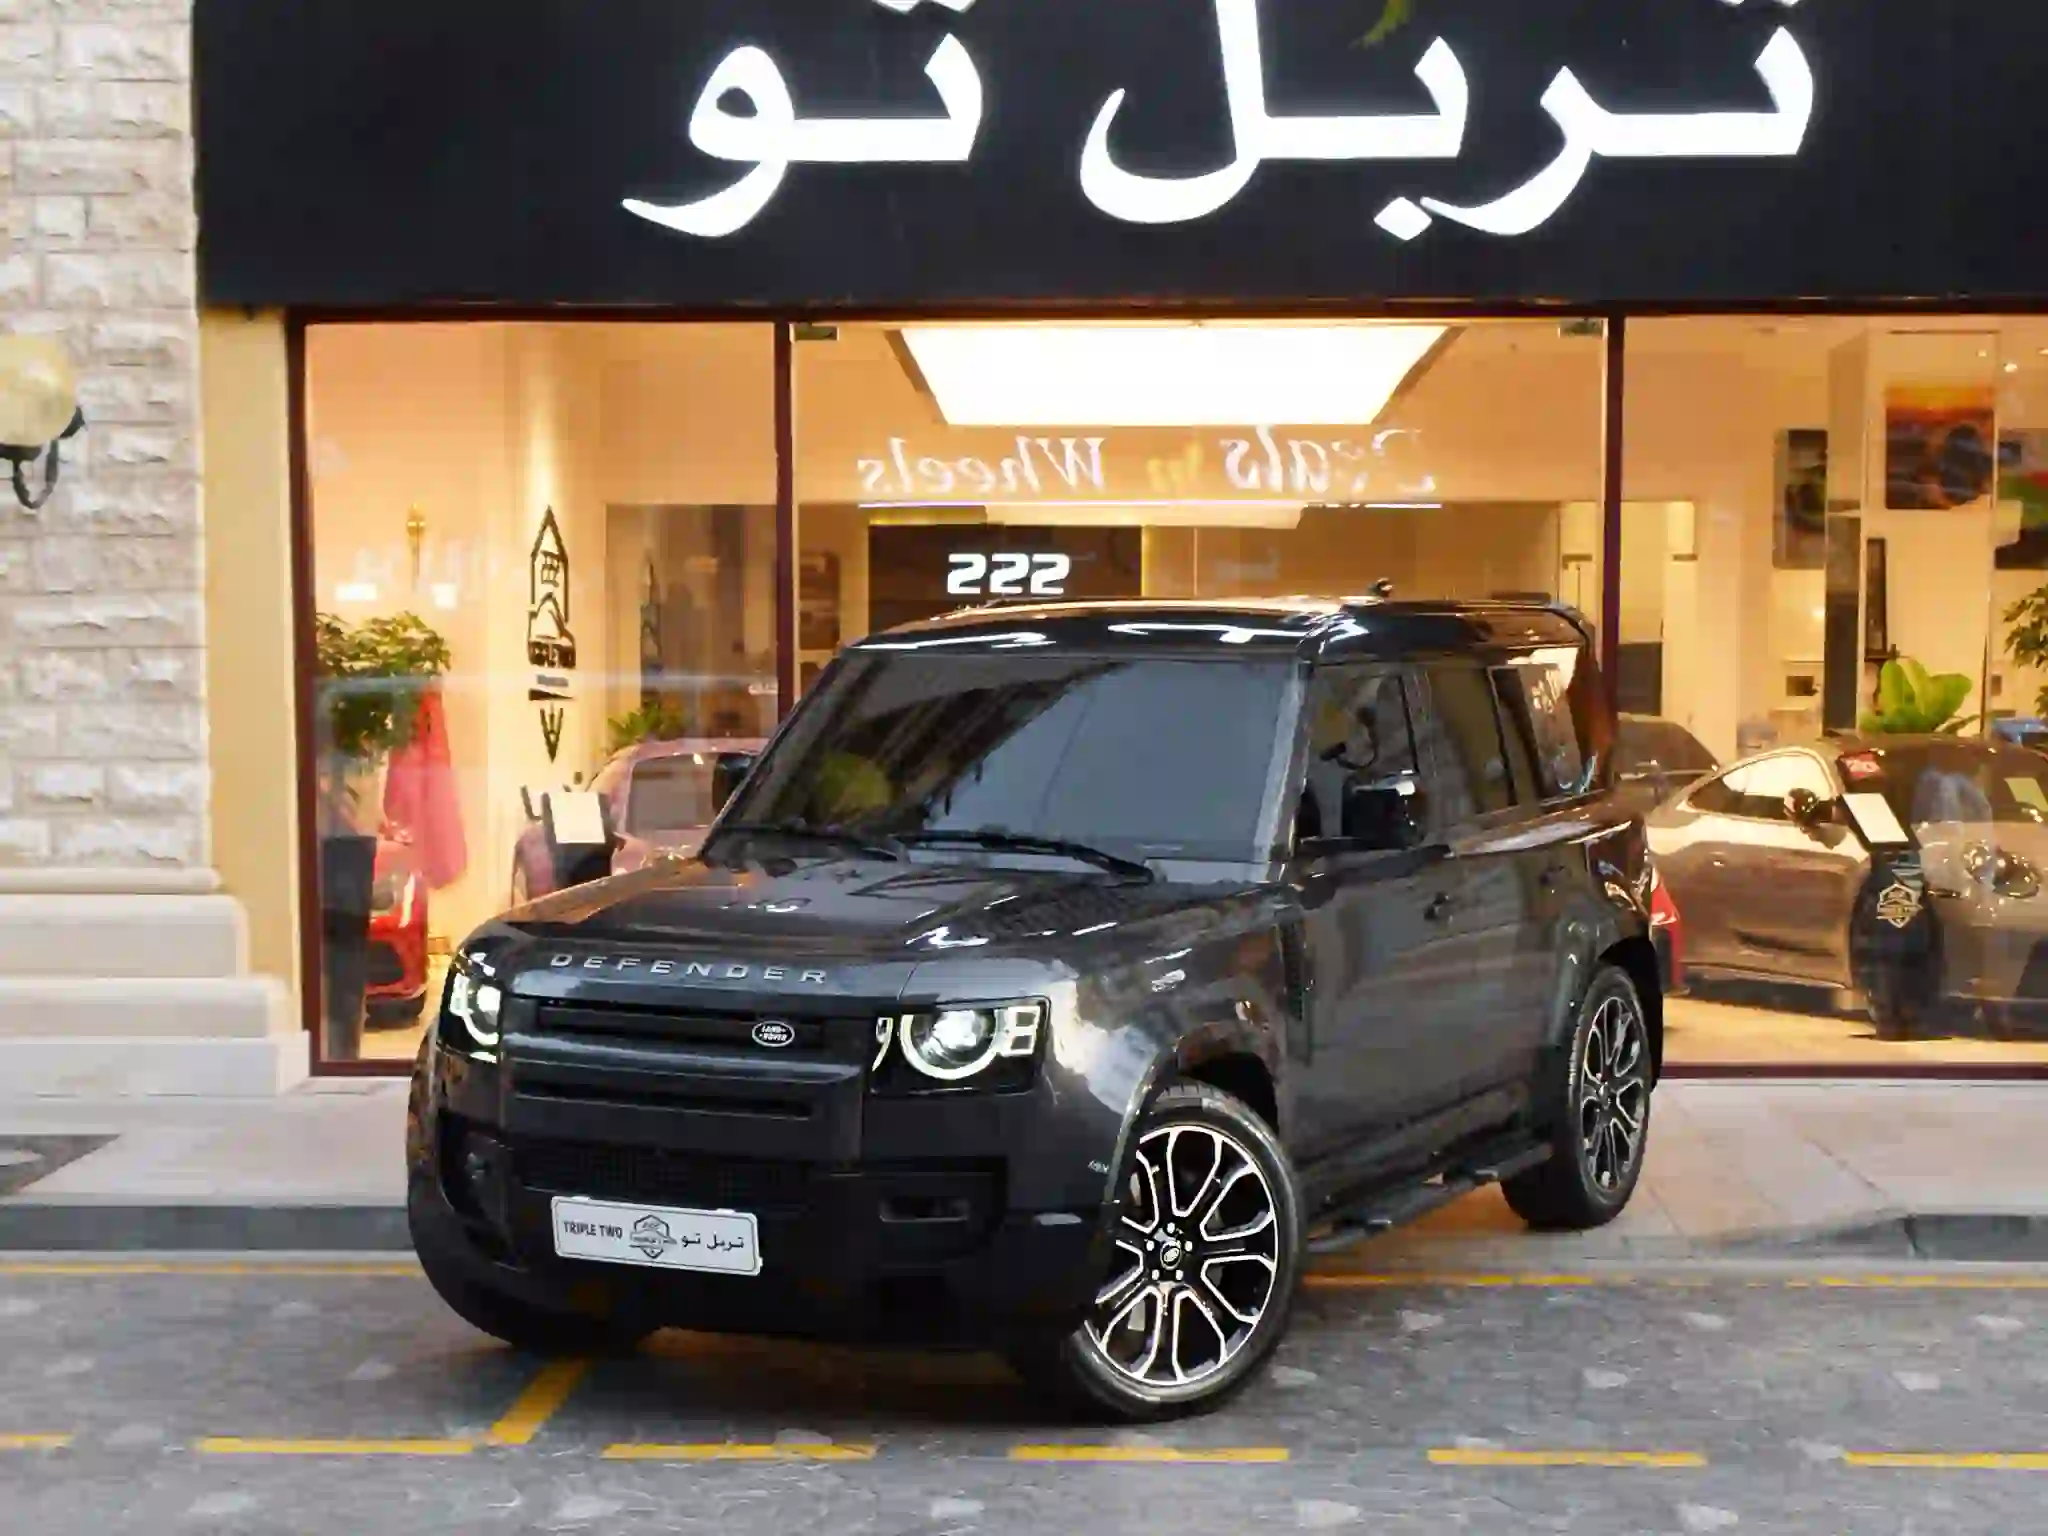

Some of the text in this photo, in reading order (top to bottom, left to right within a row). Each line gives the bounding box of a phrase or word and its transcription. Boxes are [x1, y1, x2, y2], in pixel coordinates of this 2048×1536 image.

[947, 553, 1070, 594] 222
[550, 953, 828, 984] DEFENDER
[563, 1221, 623, 1239] TRIPLE TWO
